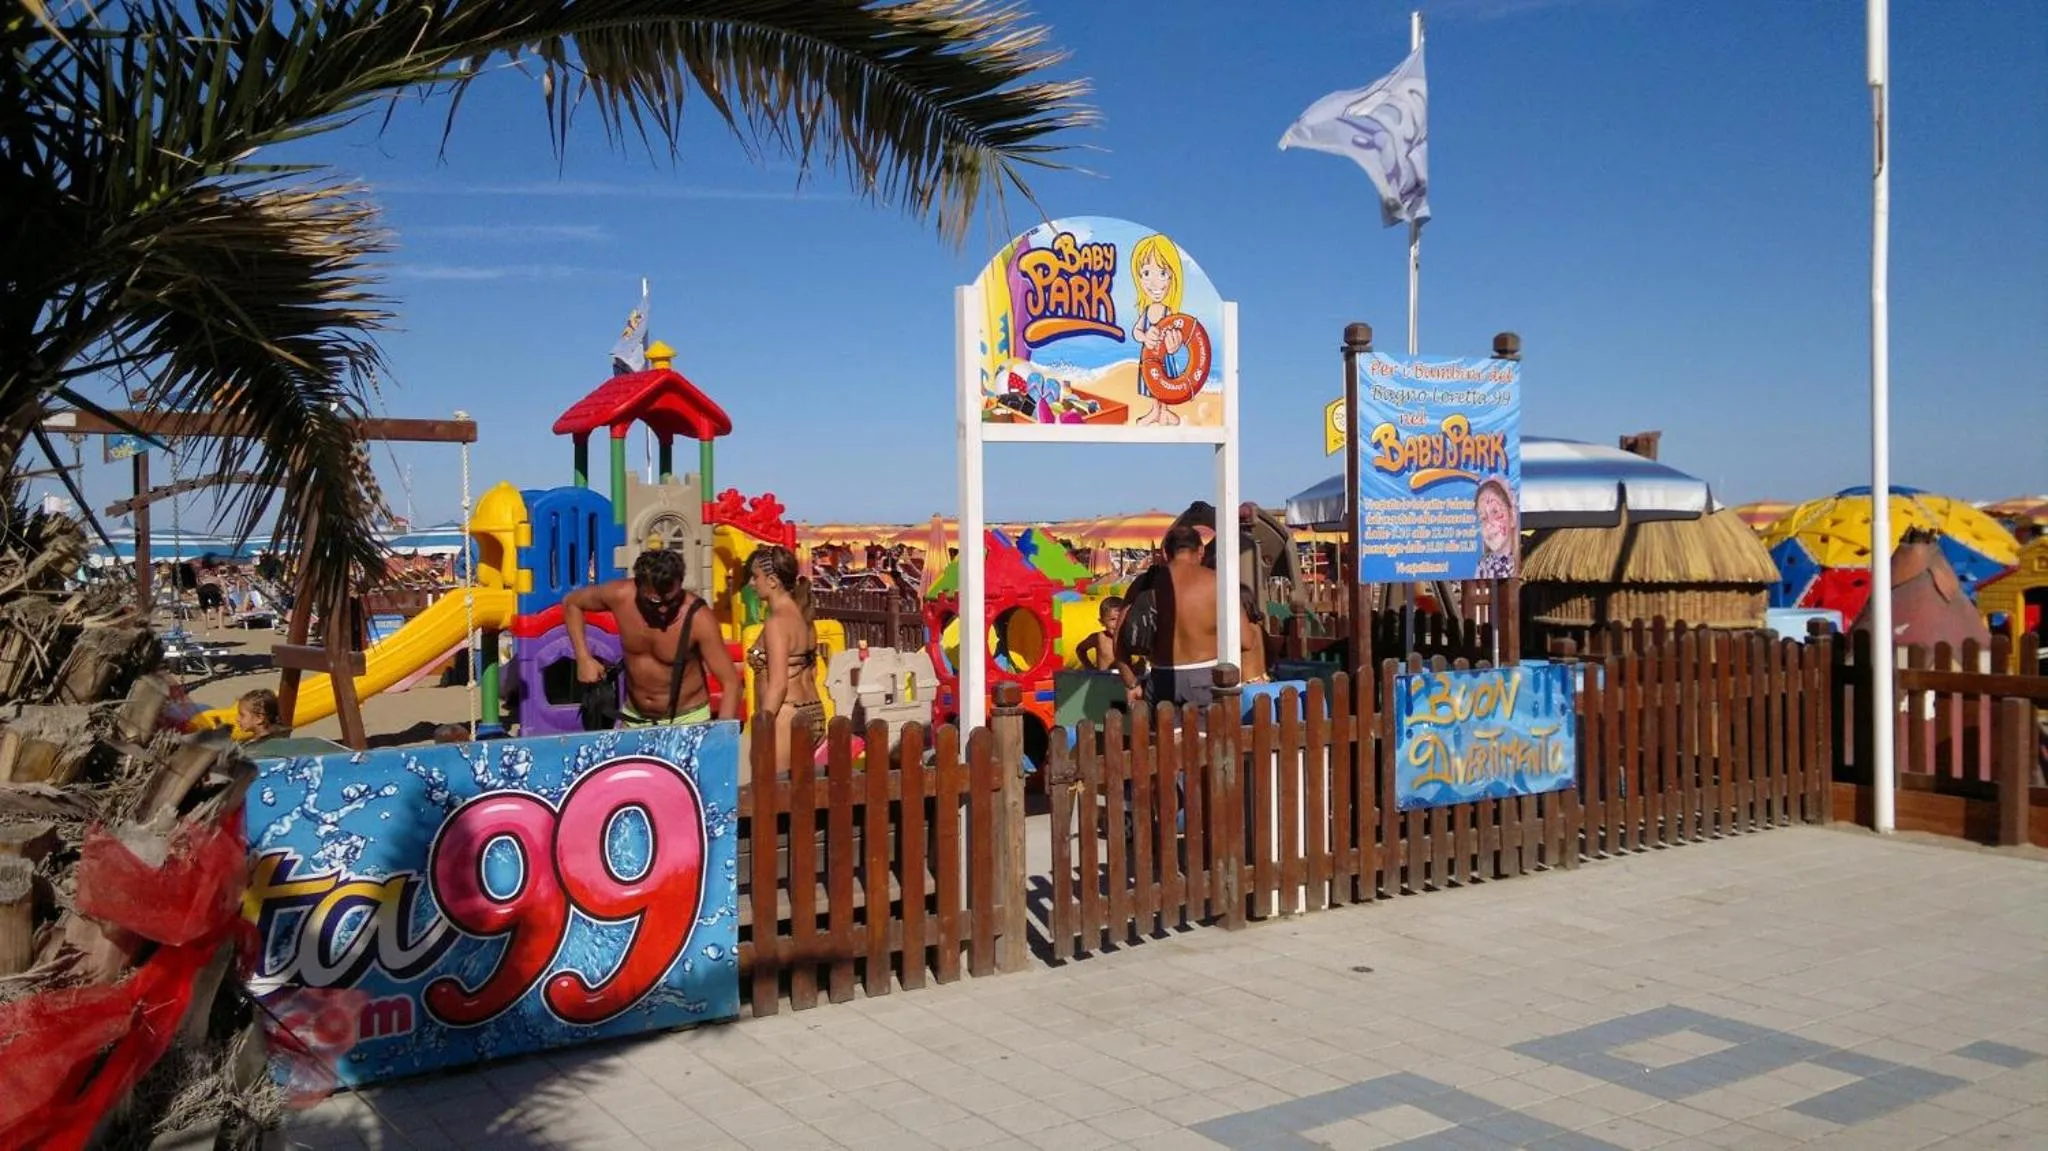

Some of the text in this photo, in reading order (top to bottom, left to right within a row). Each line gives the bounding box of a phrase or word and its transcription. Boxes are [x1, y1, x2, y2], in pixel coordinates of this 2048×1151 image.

[1053, 232, 1116, 273] BABY
[1018, 248, 1116, 323] PARK
[1372, 384, 1428, 406] Bagno
[1371, 413, 1509, 473] BABY PARK
[423, 754, 708, 1028] 99
